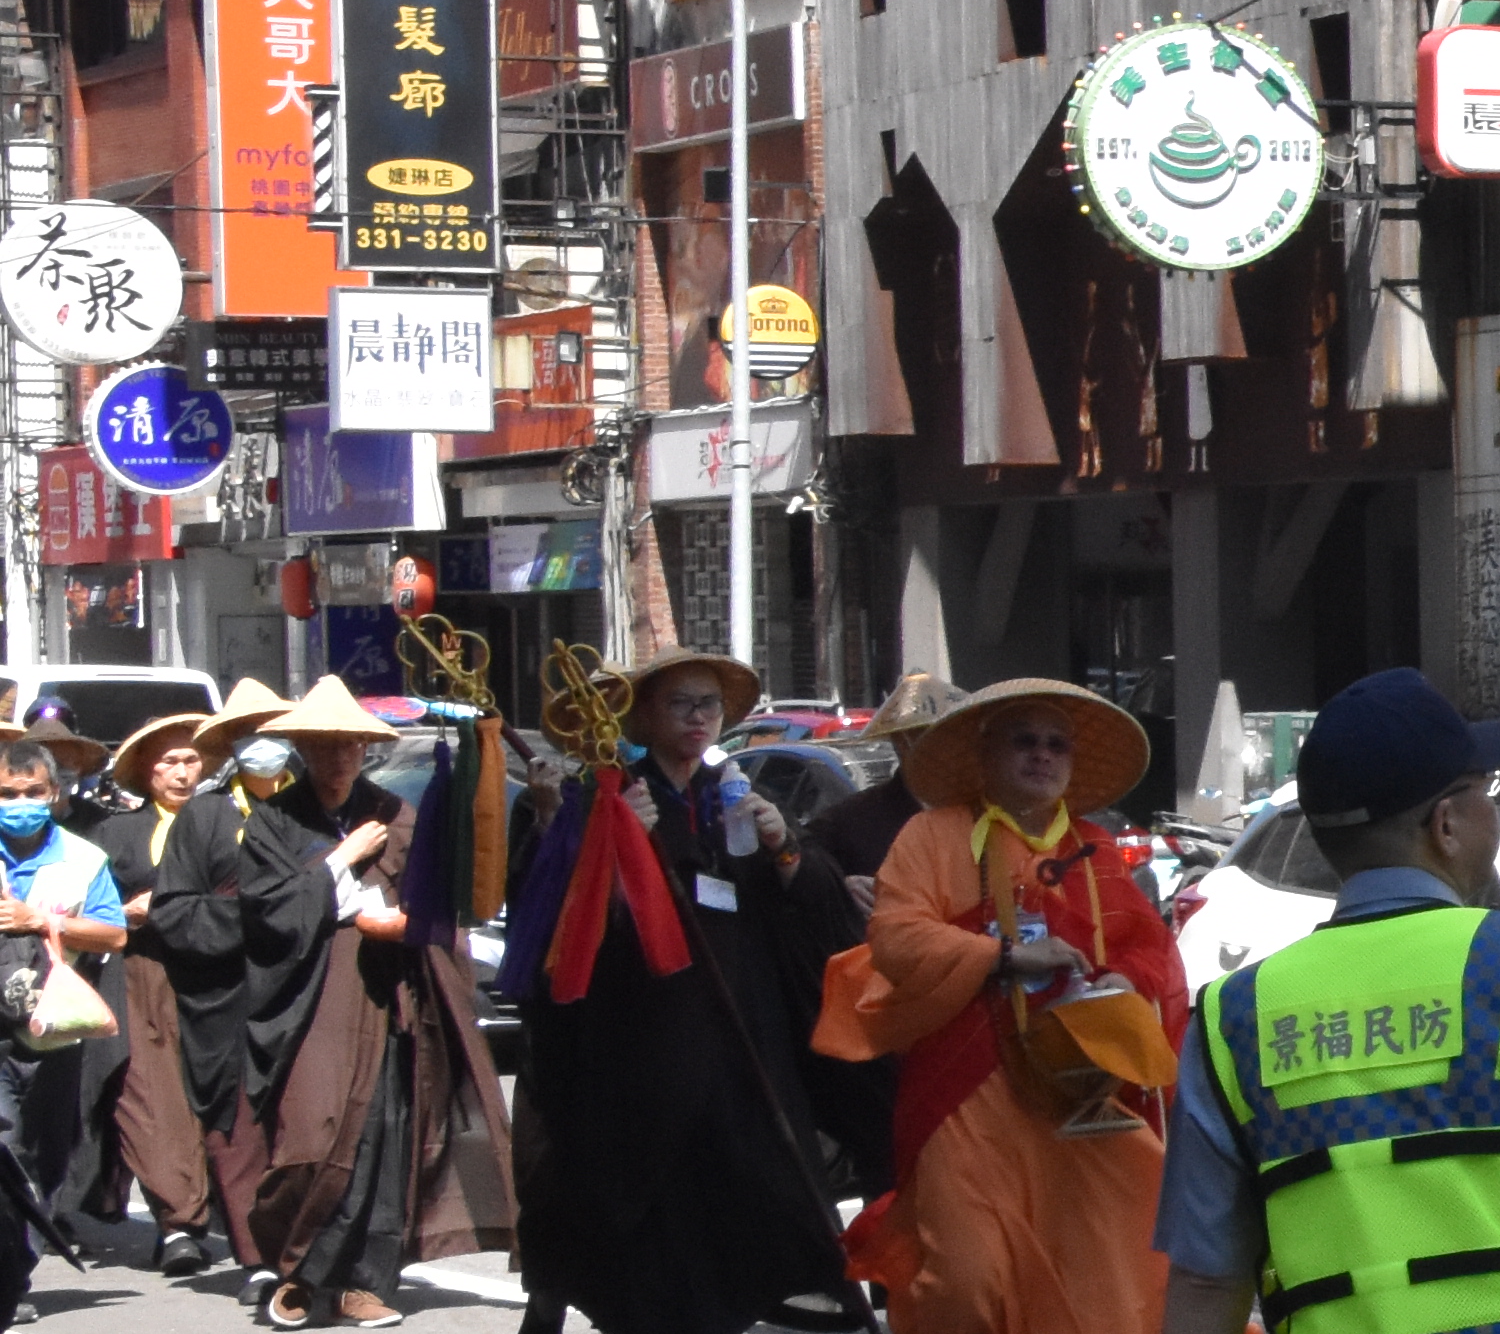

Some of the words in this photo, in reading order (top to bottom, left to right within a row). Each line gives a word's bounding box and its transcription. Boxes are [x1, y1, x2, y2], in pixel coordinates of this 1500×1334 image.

[391, 6, 445, 116] 髮廊
[690, 62, 759, 110] CROS
[357, 229, 487, 252] 331-3230
[1268, 998, 1454, 1074] 景福民防
